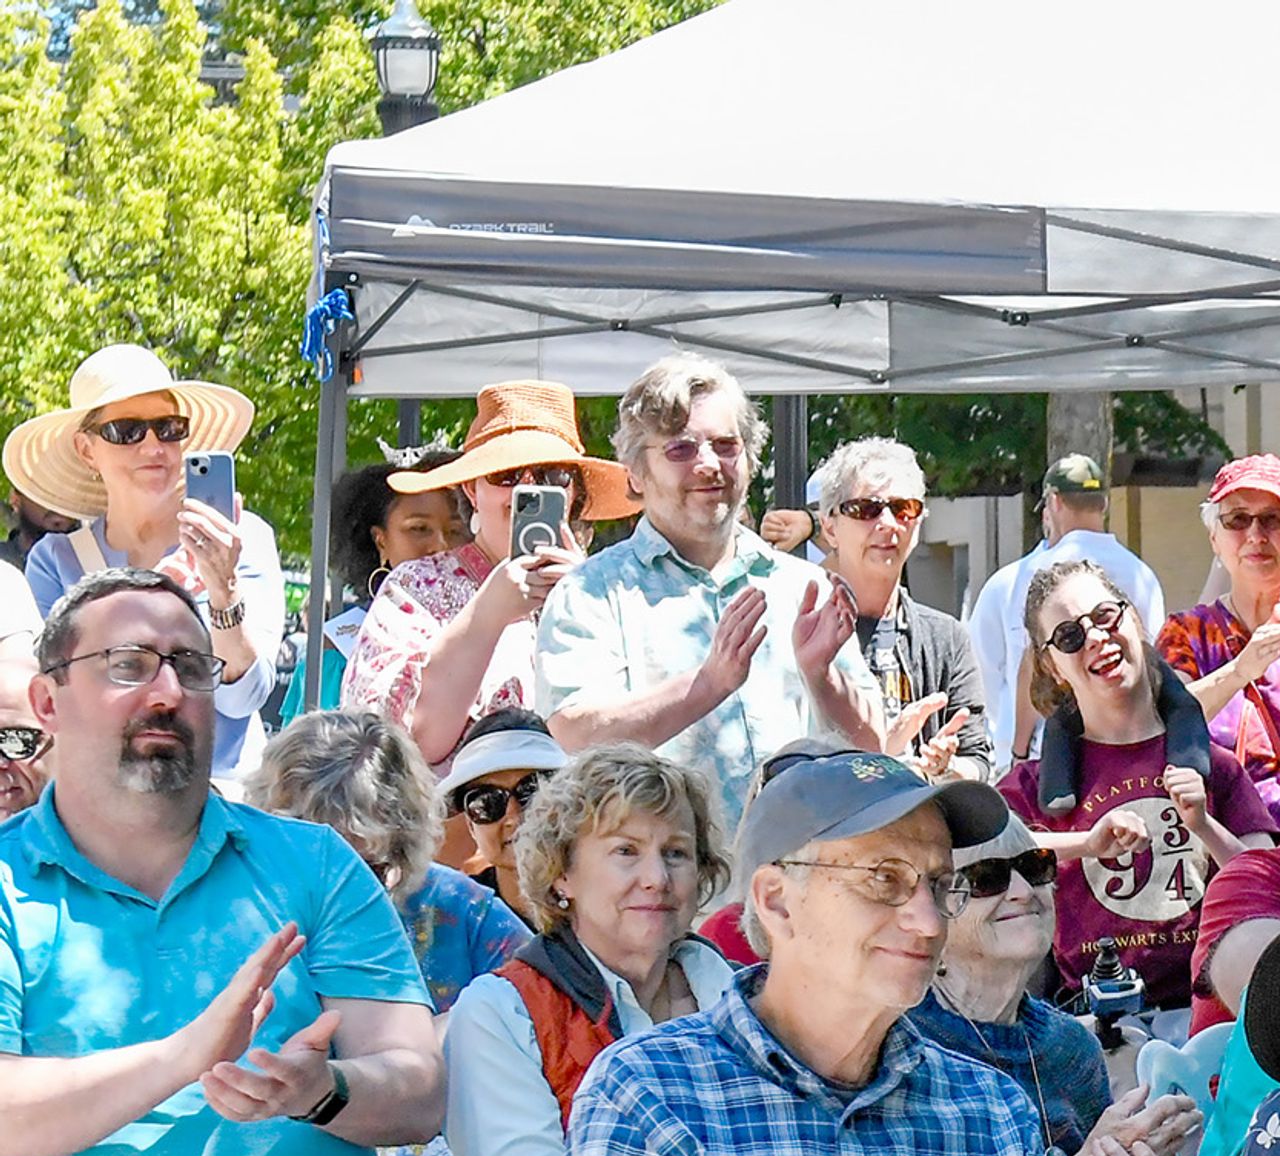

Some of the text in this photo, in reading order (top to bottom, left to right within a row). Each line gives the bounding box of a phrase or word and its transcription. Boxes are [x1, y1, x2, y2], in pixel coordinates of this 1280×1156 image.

[1083, 775, 1165, 813] PLATFO
[1159, 806, 1191, 848] 3
[1165, 858, 1193, 902] 4
